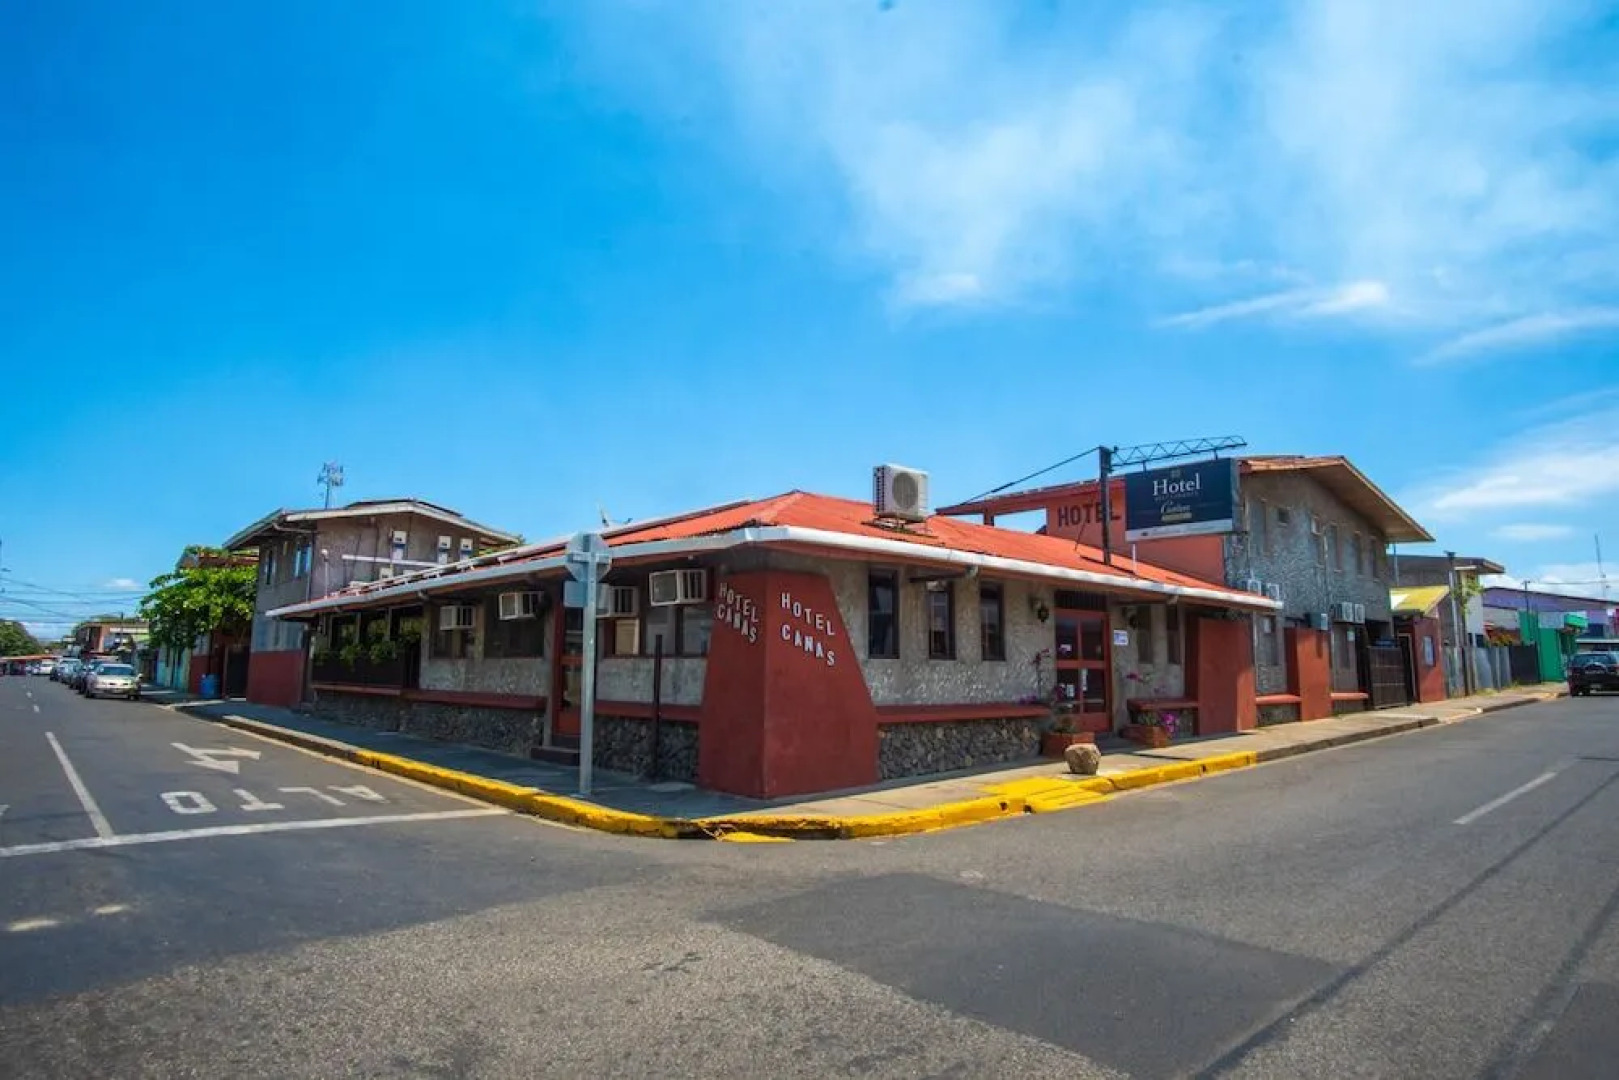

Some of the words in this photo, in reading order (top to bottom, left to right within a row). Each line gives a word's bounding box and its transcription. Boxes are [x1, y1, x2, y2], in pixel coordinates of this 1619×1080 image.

[1152, 473, 1201, 496] Hotel
[1057, 502, 1122, 527] HOTEL
[720, 582, 759, 623] HOTEL
[781, 592, 835, 636] HOTEL
[160, 785, 390, 814] ALTO
